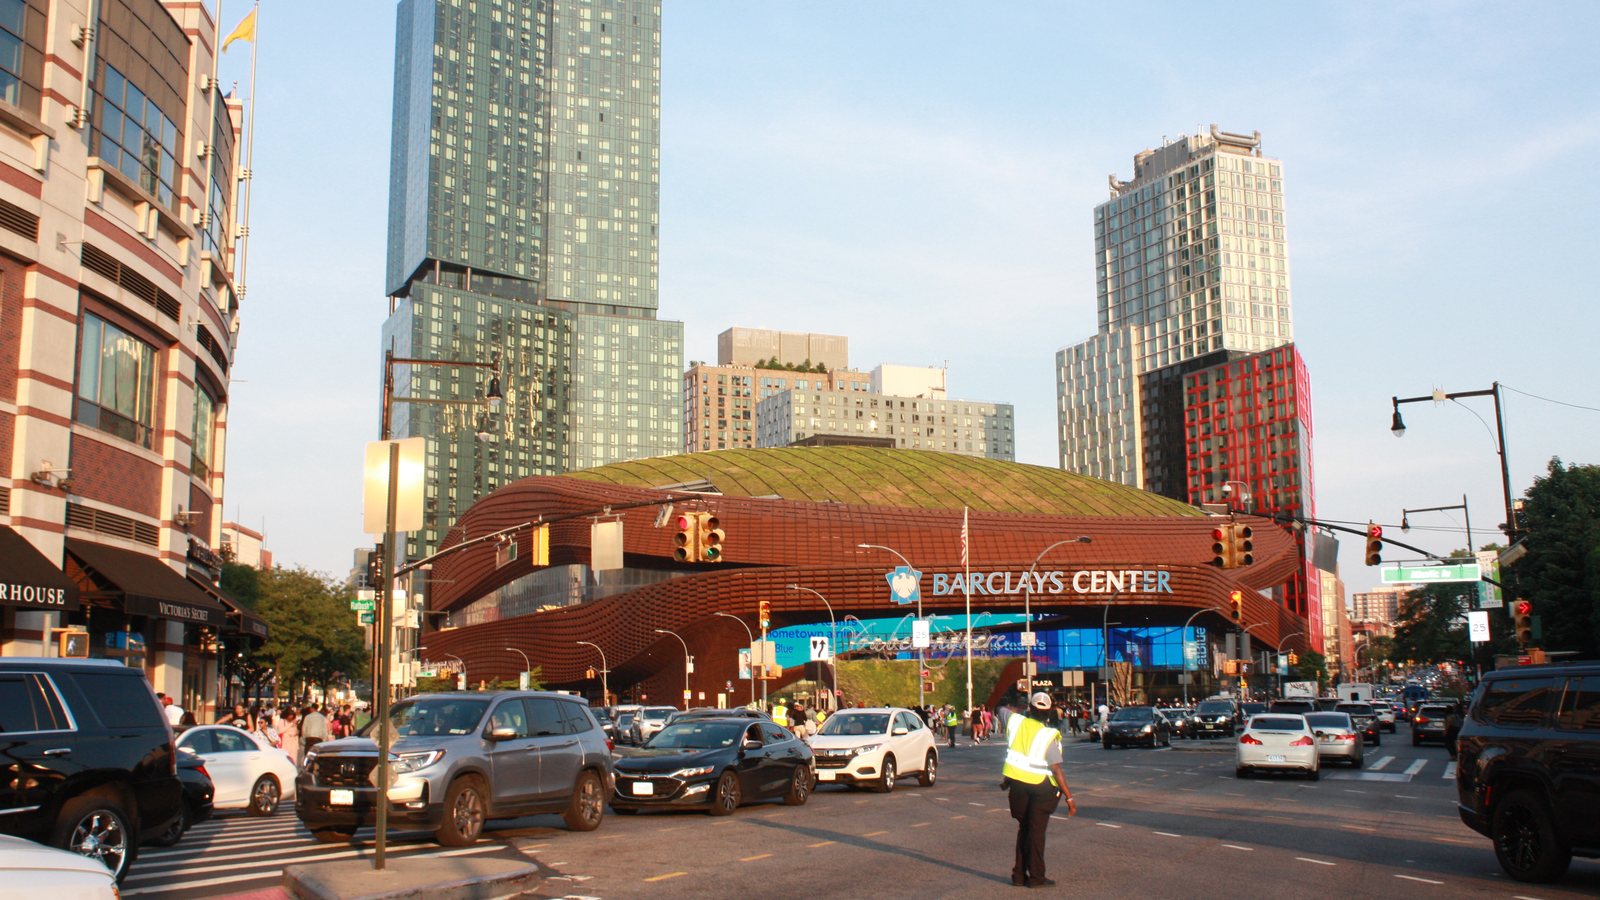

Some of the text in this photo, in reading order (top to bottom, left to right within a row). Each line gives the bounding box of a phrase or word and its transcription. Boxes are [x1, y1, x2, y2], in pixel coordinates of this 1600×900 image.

[932, 570, 1174, 596] BARCLAYS CENTER
[0, 583, 65, 605] RHOUSE
[159, 601, 208, 621] VICTORIA'S SECRET
[915, 631, 927, 639] 25
[1472, 623, 1487, 632] 25
[775, 643, 793, 654] Blue
